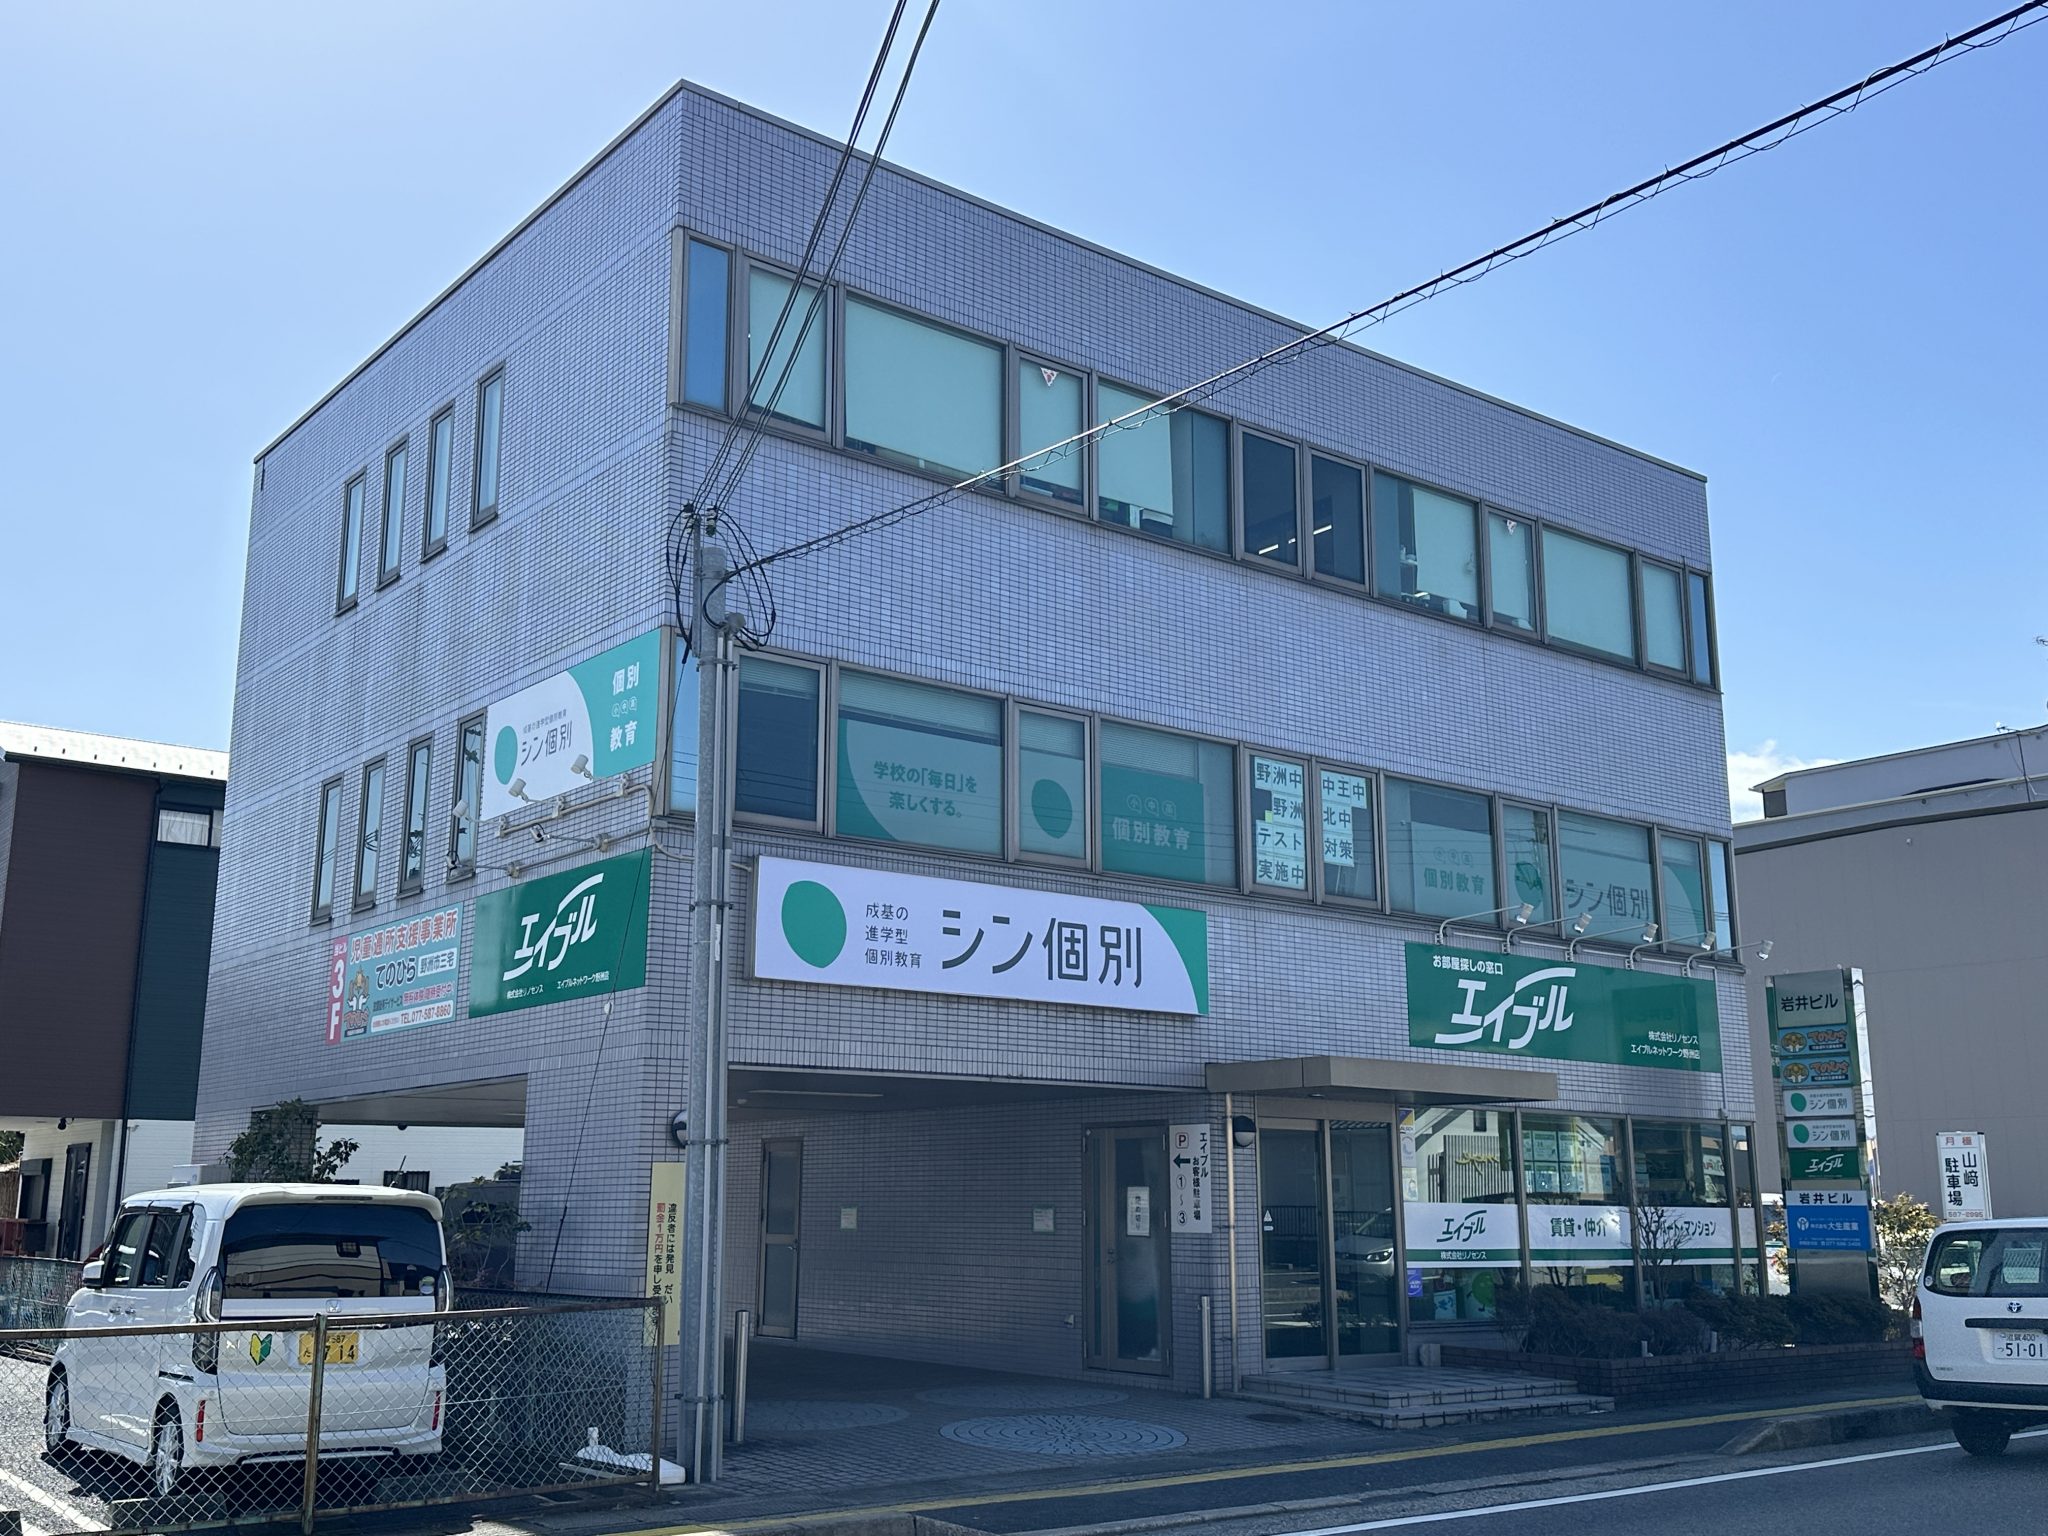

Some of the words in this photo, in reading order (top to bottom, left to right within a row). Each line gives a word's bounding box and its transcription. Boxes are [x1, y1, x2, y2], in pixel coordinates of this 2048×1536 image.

[613, 662, 640, 696] 個別
[521, 720, 573, 766] シン個別
[610, 720, 638, 752] 教育
[873, 761, 977, 793] 学校の「毎日」を
[1256, 762, 1302, 789] 野洲中
[1322, 776, 1365, 801] 中主中
[889, 792, 962, 818] 楽しくする。
[1323, 807, 1351, 829] 北中
[1112, 817, 1190, 850] 個別教育
[1258, 827, 1302, 851] テスト
[1324, 837, 1353, 860] 対策
[1258, 859, 1304, 885] 実施中
[1424, 867, 1485, 895] 個別教育
[866, 903, 909, 921] 成基の
[1567, 879, 1650, 920] シン個別
[350, 908, 458, 965] 児童通所支援事業所
[503, 873, 604, 982] エイブル
[865, 926, 908, 945] 進学型
[865, 947, 922, 969] 個別教育
[942, 907, 1142, 989] シン個別
[375, 957, 417, 990] てのひら
[1433, 954, 1504, 976] お部屋探しの窓口
[1435, 967, 1577, 1049] エイブル
[1781, 993, 1838, 1012] 岩井ビル
[1648, 1030, 1699, 1045] 株式会社リノセンス
[1809, 1098, 1848, 1111] シン個別
[1178, 1134, 1187, 1147] P
[1812, 1130, 1851, 1142] シン個別
[1200, 1132, 1208, 1178] エイブル
[1805, 1153, 1844, 1172] エイブル
[1945, 1157, 1963, 1207] 駐車場
[1799, 1192, 1853, 1205] 岩井ビル
[1436, 1210, 1487, 1242] エイブル
[1550, 1217, 1607, 1238] 賃貸・仲介
[1440, 1250, 1488, 1261] 株式会社リノセンス
[2005, 1342, 2043, 1358] 51-01
